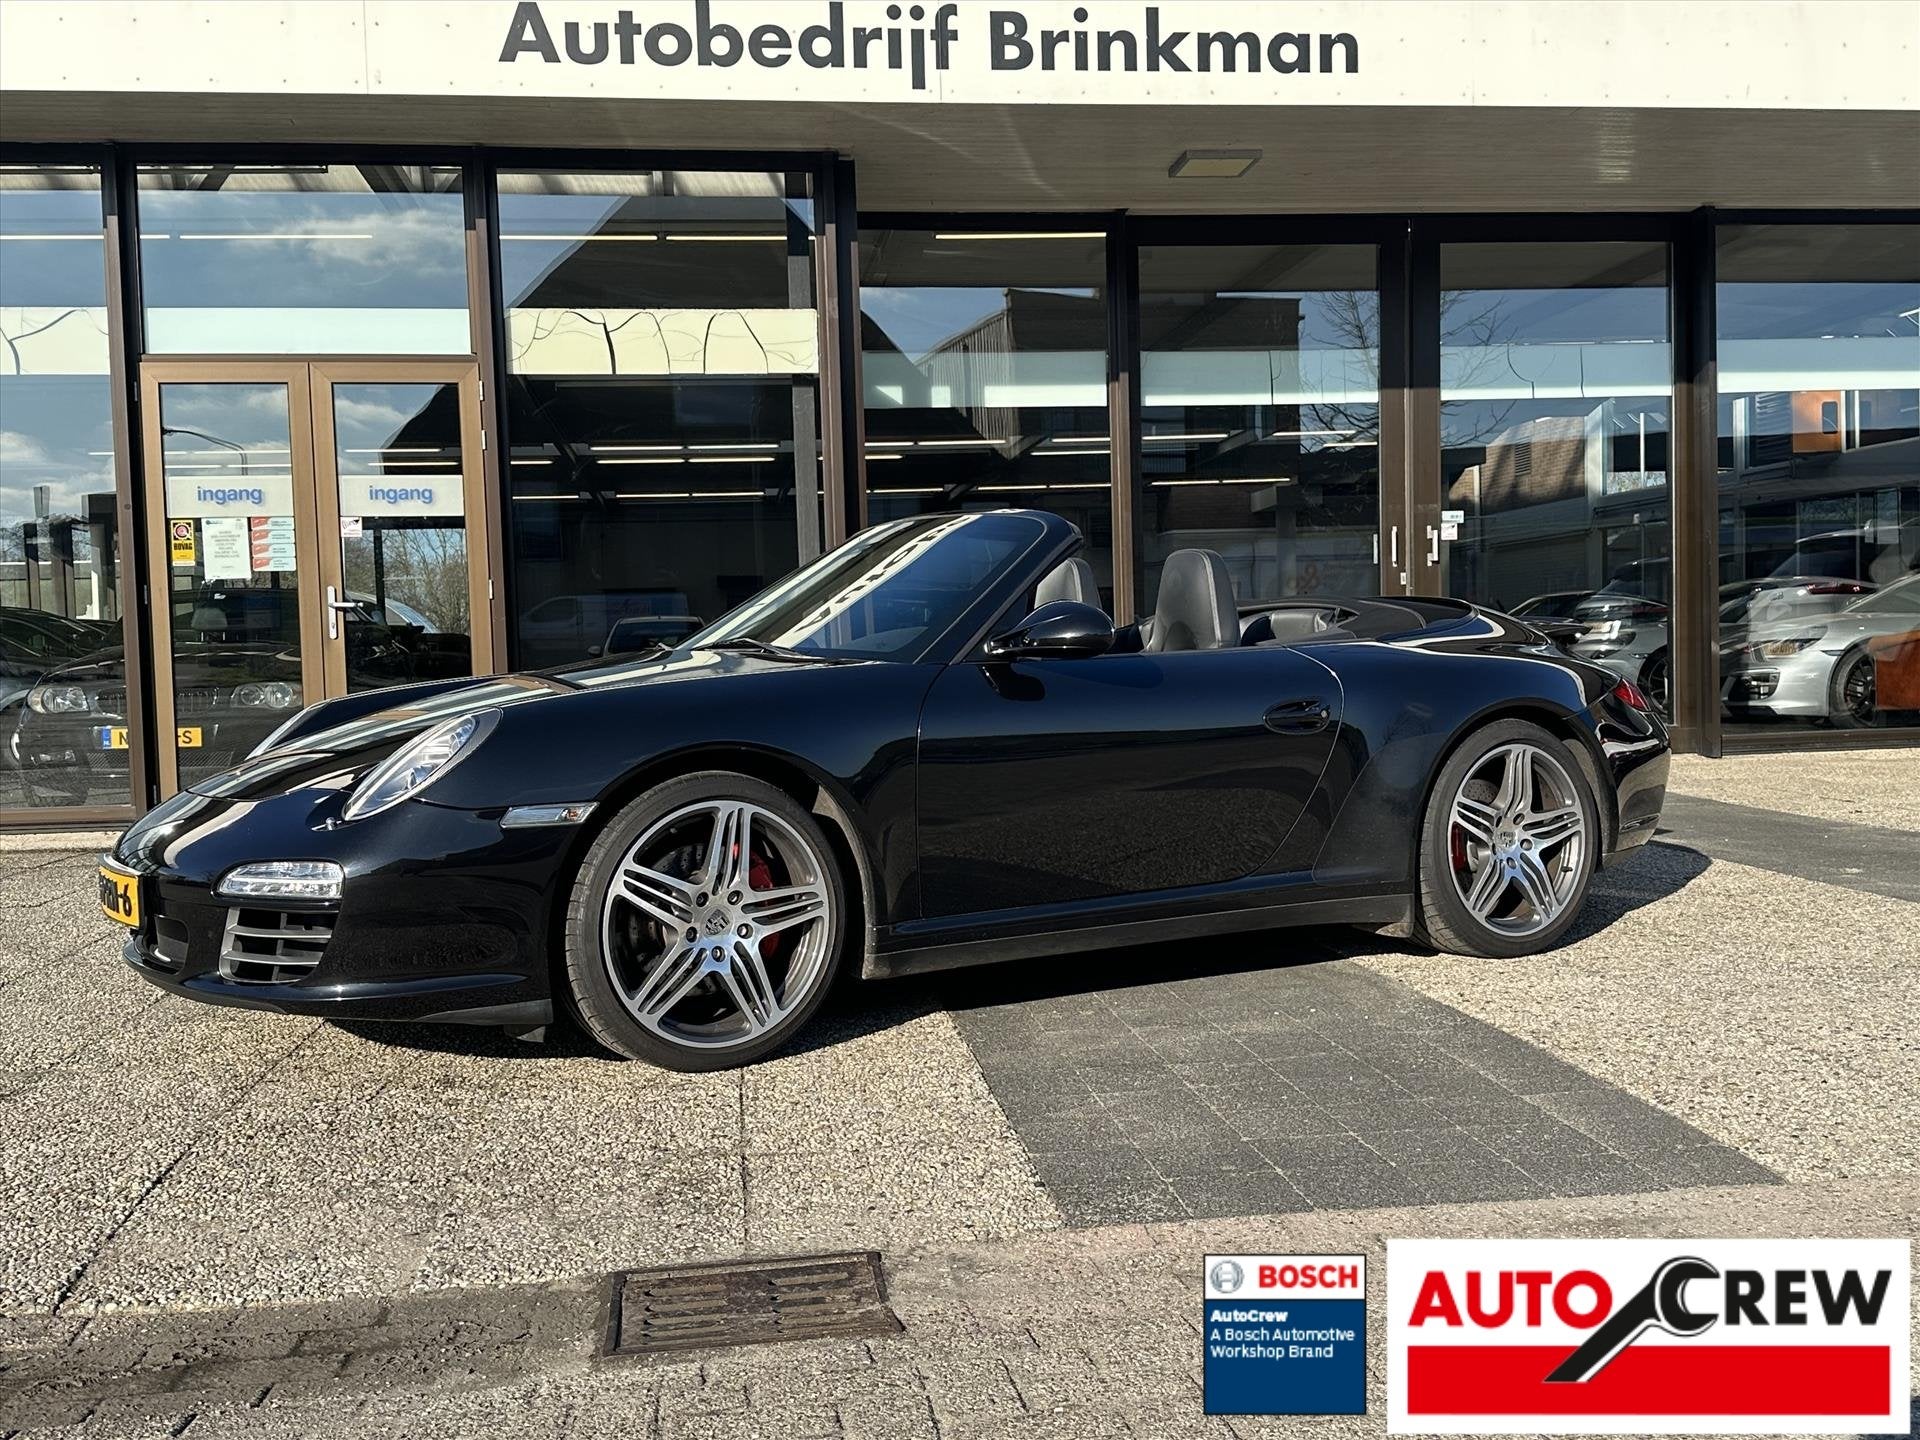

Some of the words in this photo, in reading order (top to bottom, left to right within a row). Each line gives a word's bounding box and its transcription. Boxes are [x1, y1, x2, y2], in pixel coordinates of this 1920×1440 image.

[498, 0, 959, 90] Autobedrijf
[989, 7, 1359, 74] Brinkman
[197, 485, 263, 505] ingang
[369, 485, 433, 504] ingang
